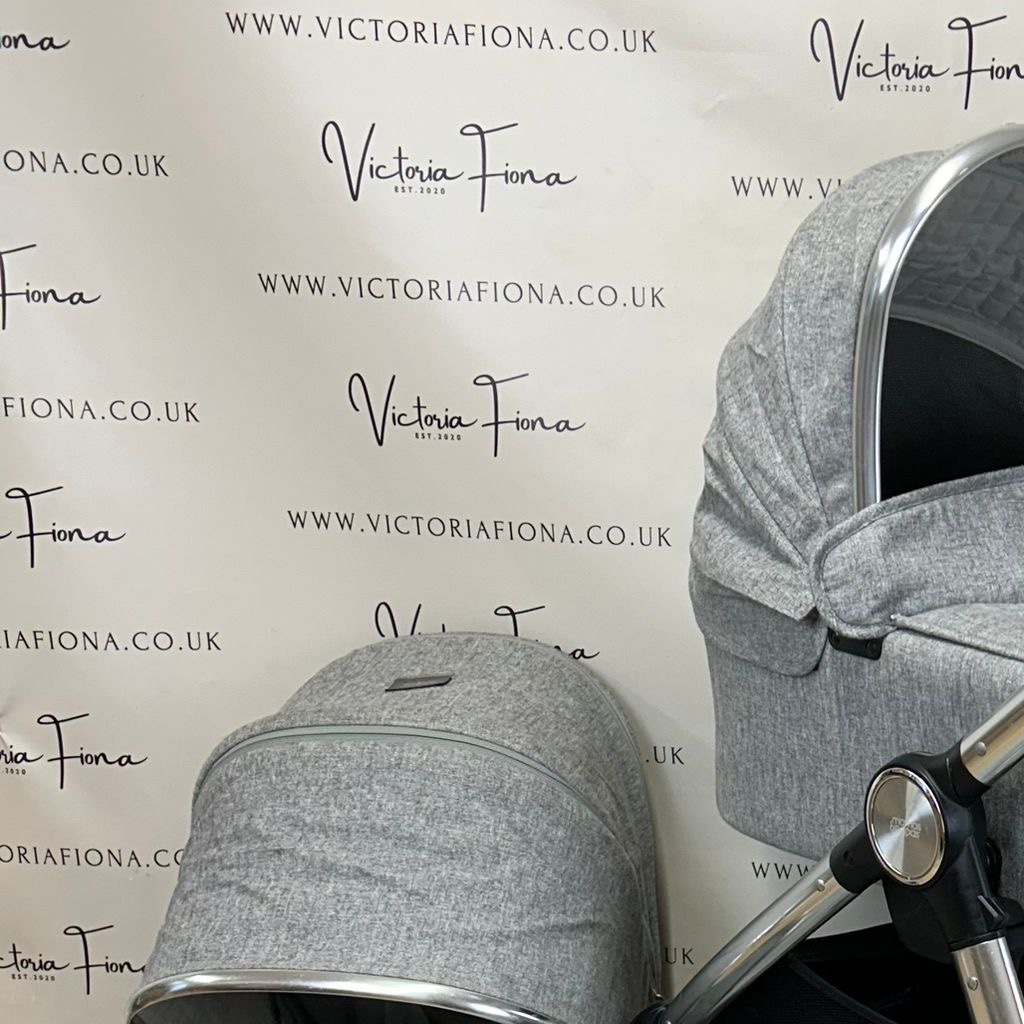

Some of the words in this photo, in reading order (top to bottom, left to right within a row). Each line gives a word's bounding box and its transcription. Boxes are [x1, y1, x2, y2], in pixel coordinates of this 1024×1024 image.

[224, 11, 658, 54] WWW.VICTORIAFIONA.CO.UK
[809, 17, 949, 102] Victoria
[320, 120, 466, 203] Victoria
[460, 122, 578, 213] Fiona
[257, 272, 666, 309] WWW.VICTORIAFIONA.CO.UK
[347, 372, 480, 448] Victoria
[473, 372, 587, 458] Fiona
[5, 485, 127, 569] Fiona
[286, 509, 673, 548] WWW.VICTORIAFIONA.CO.UK
[37, 712, 149, 791] Fiona
